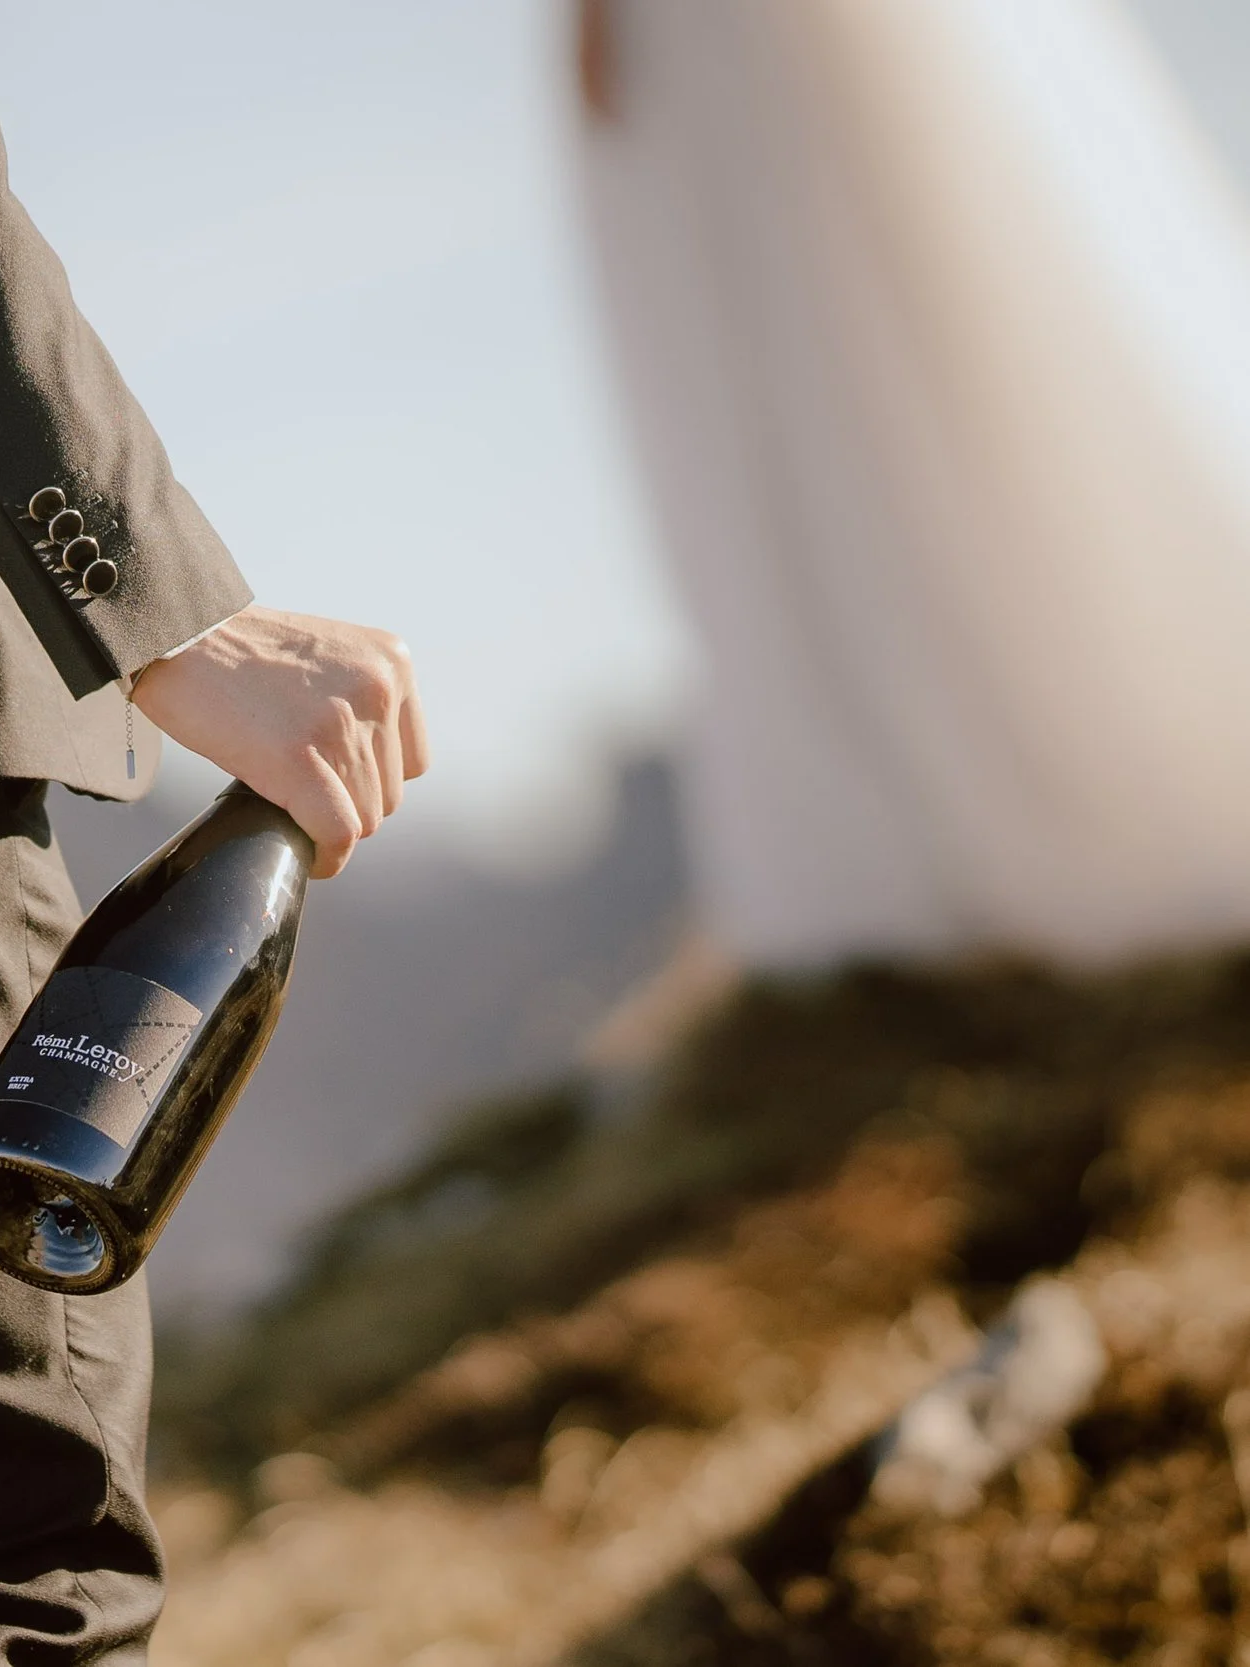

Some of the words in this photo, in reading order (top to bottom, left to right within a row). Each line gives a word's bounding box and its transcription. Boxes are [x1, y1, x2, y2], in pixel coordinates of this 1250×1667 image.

[31, 1034, 73, 1049] Rémi
[73, 1035, 144, 1082] Leroy
[39, 1048, 118, 1078] CHAMPAGNE
